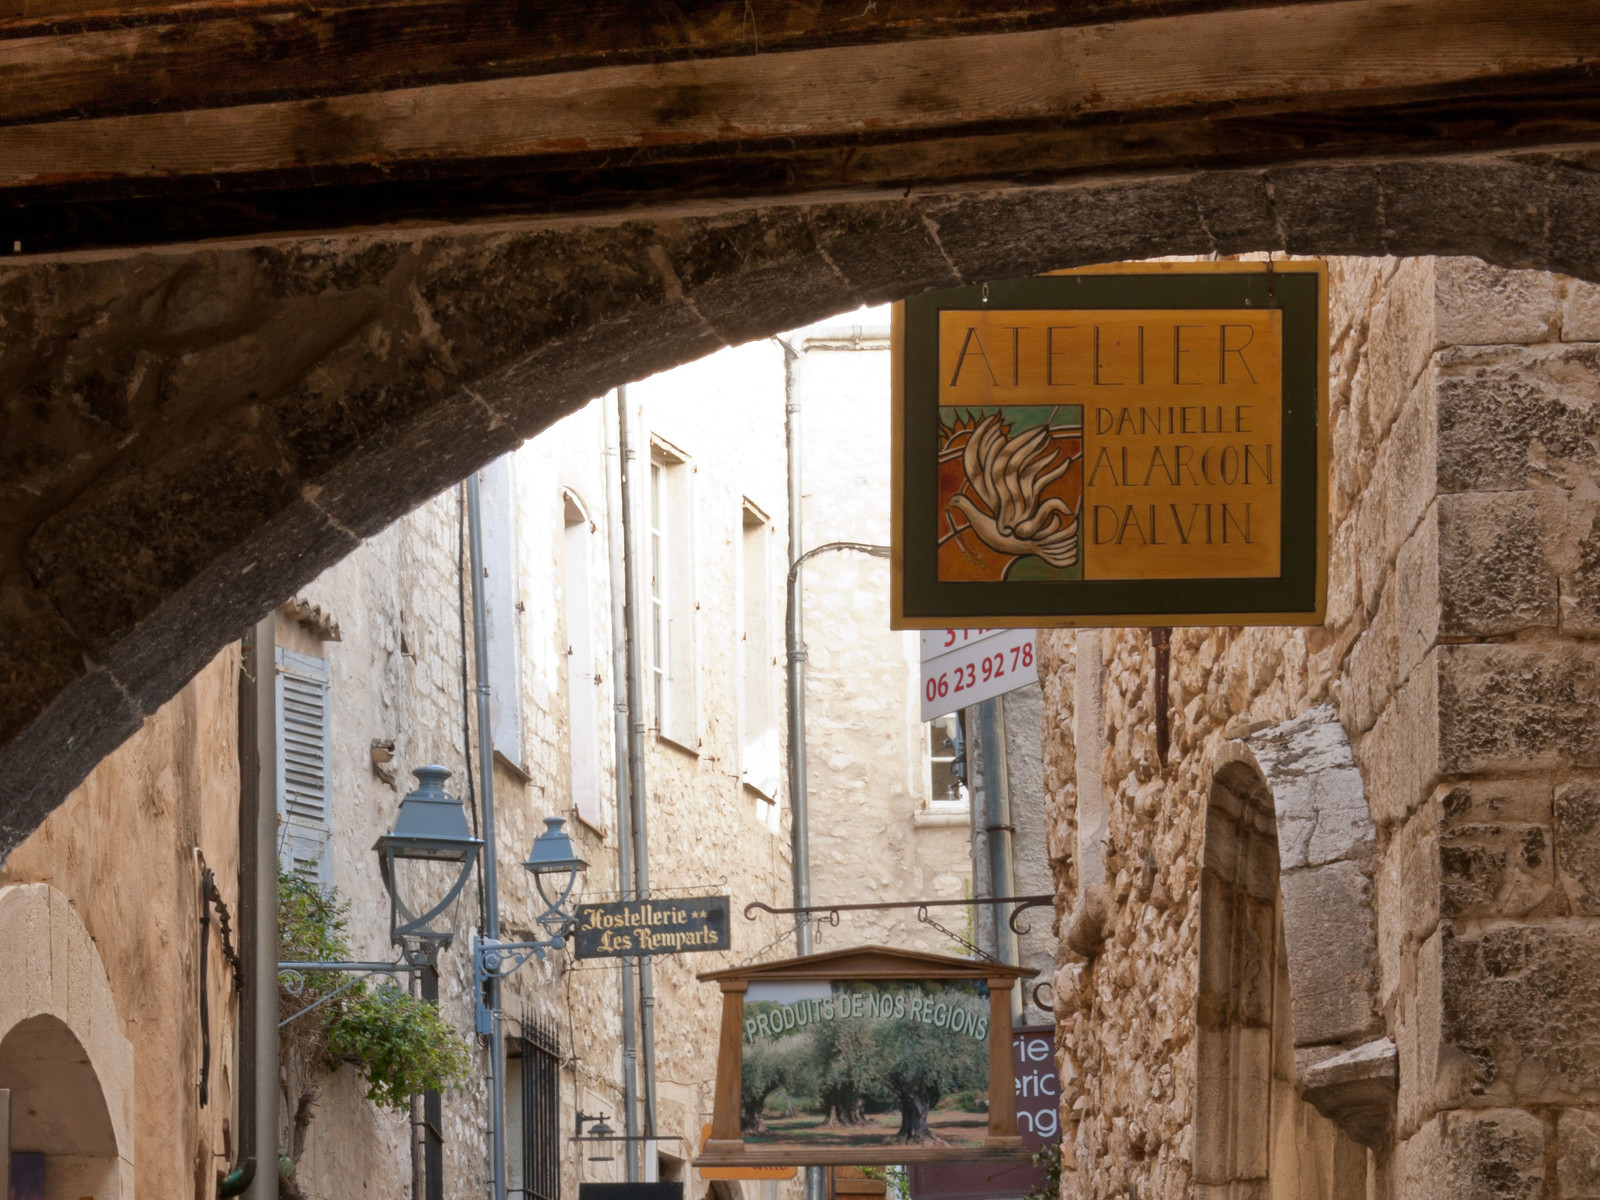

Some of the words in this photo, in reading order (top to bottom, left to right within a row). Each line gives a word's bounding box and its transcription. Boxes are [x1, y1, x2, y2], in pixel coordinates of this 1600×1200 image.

[949, 324, 1258, 387] ATELIER
[1095, 405, 1253, 436] DANIELLE
[1087, 444, 1273, 487] ALARCON
[1093, 503, 1253, 545] DALVIN
[926, 672, 949, 702] 06
[954, 663, 976, 693] 23
[982, 652, 1004, 682] 92
[1010, 642, 1033, 672] 78
[581, 904, 688, 931] Hostellerie
[596, 930, 632, 953] Les
[633, 924, 719, 951] Remparts
[745, 998, 836, 1043] PRODUITS
[840, 993, 863, 1018] DE
[868, 993, 905, 1019] NOS
[910, 997, 989, 1041] REGIONS
